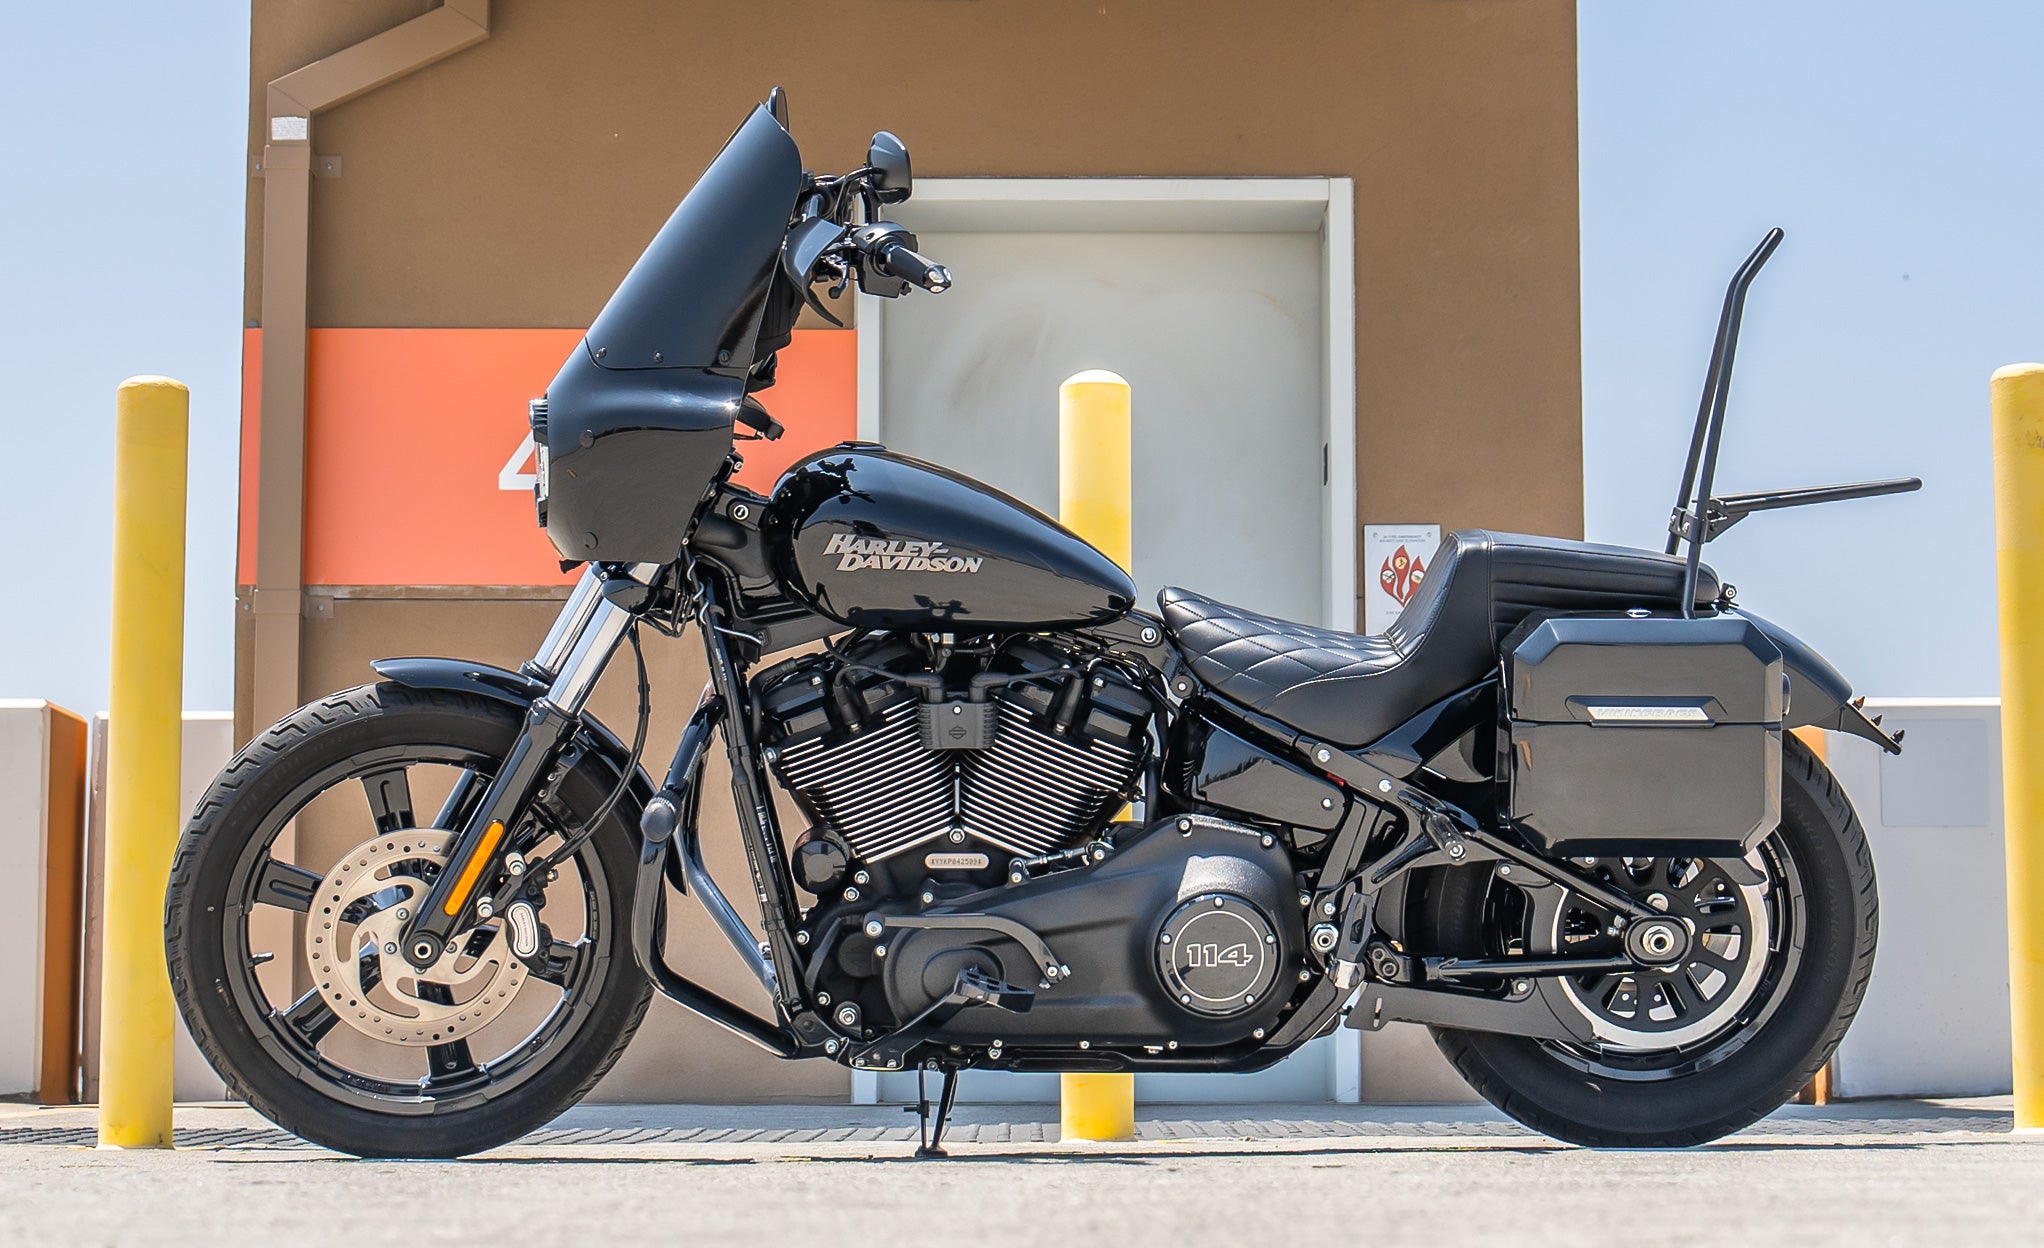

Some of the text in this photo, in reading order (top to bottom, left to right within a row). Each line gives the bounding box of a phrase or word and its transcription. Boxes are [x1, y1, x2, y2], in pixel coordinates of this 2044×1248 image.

[823, 533, 950, 557] HARLEY-
[836, 553, 984, 573] DAVIDSON
[1186, 943, 1254, 967] 114
